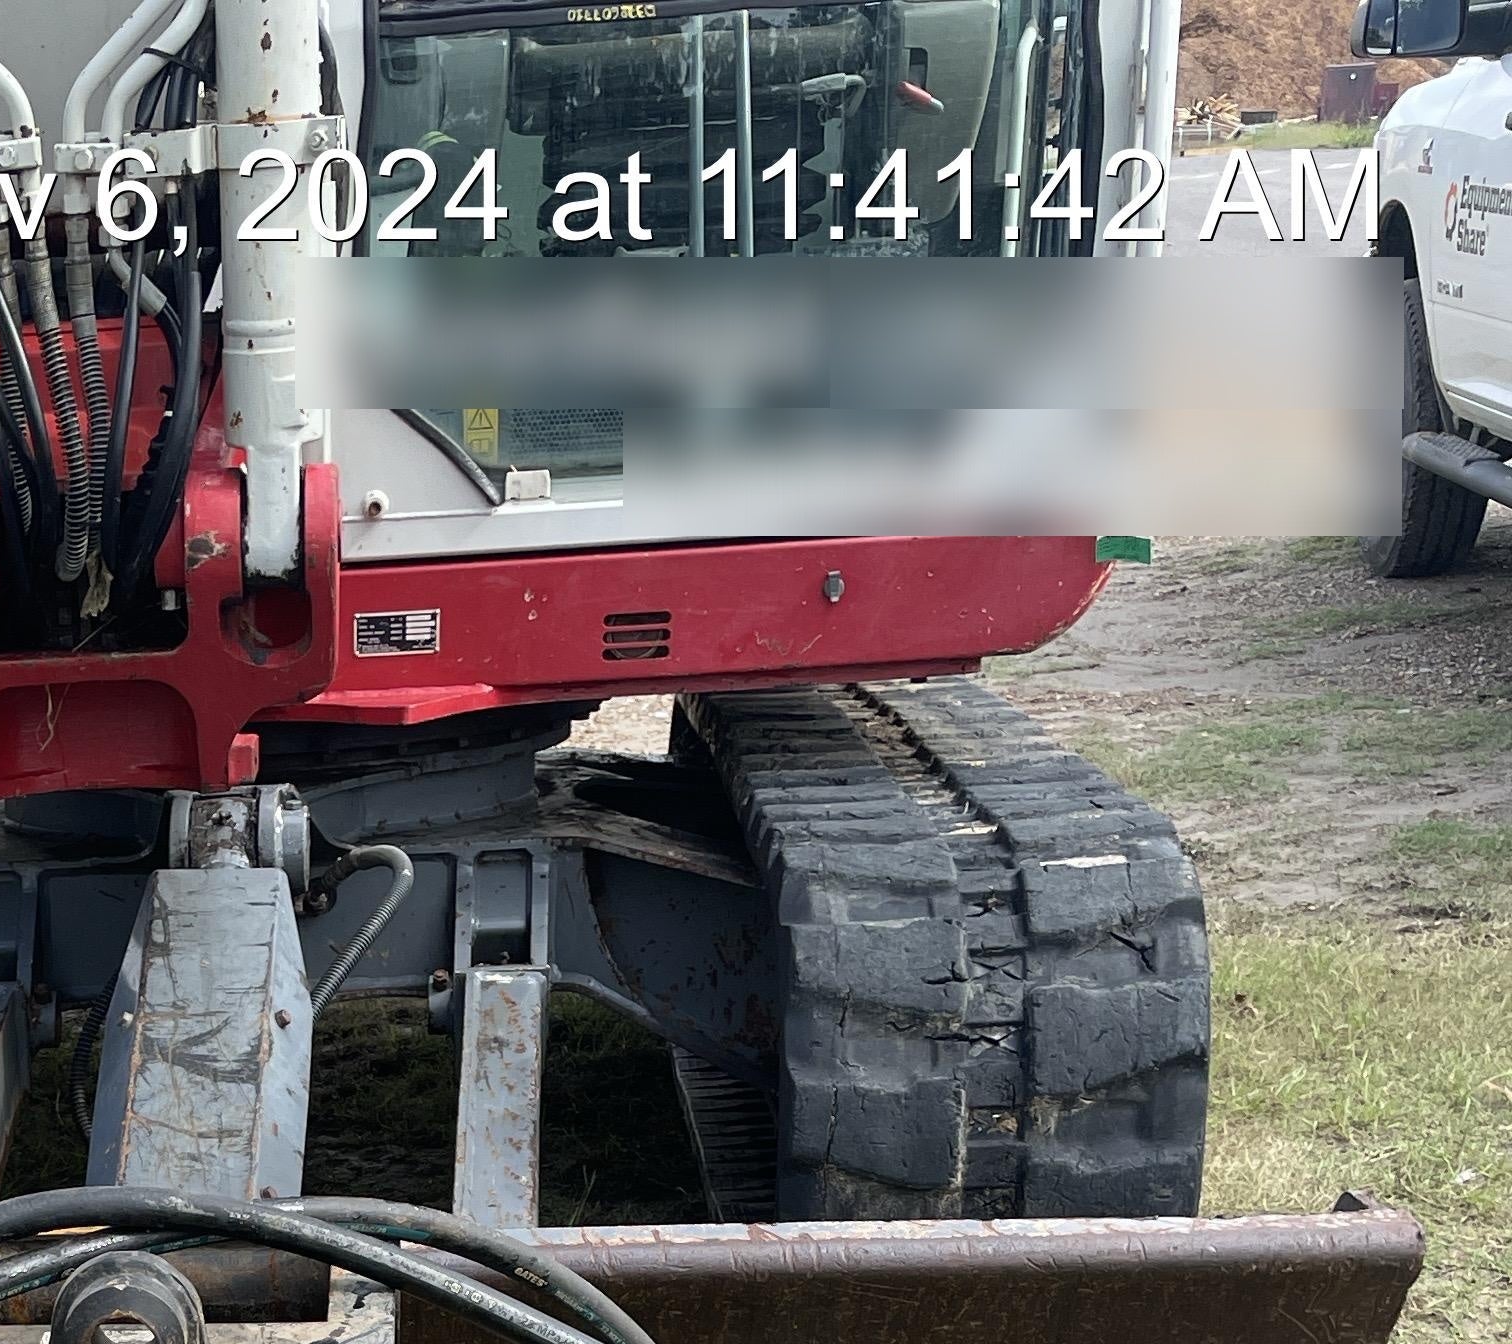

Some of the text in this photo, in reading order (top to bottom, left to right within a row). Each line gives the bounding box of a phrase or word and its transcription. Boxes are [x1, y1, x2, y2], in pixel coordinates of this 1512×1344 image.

[1460, 175, 1512, 221] Equipmen
[1456, 219, 1486, 257] Share
[513, 1266, 546, 1288] GATES
